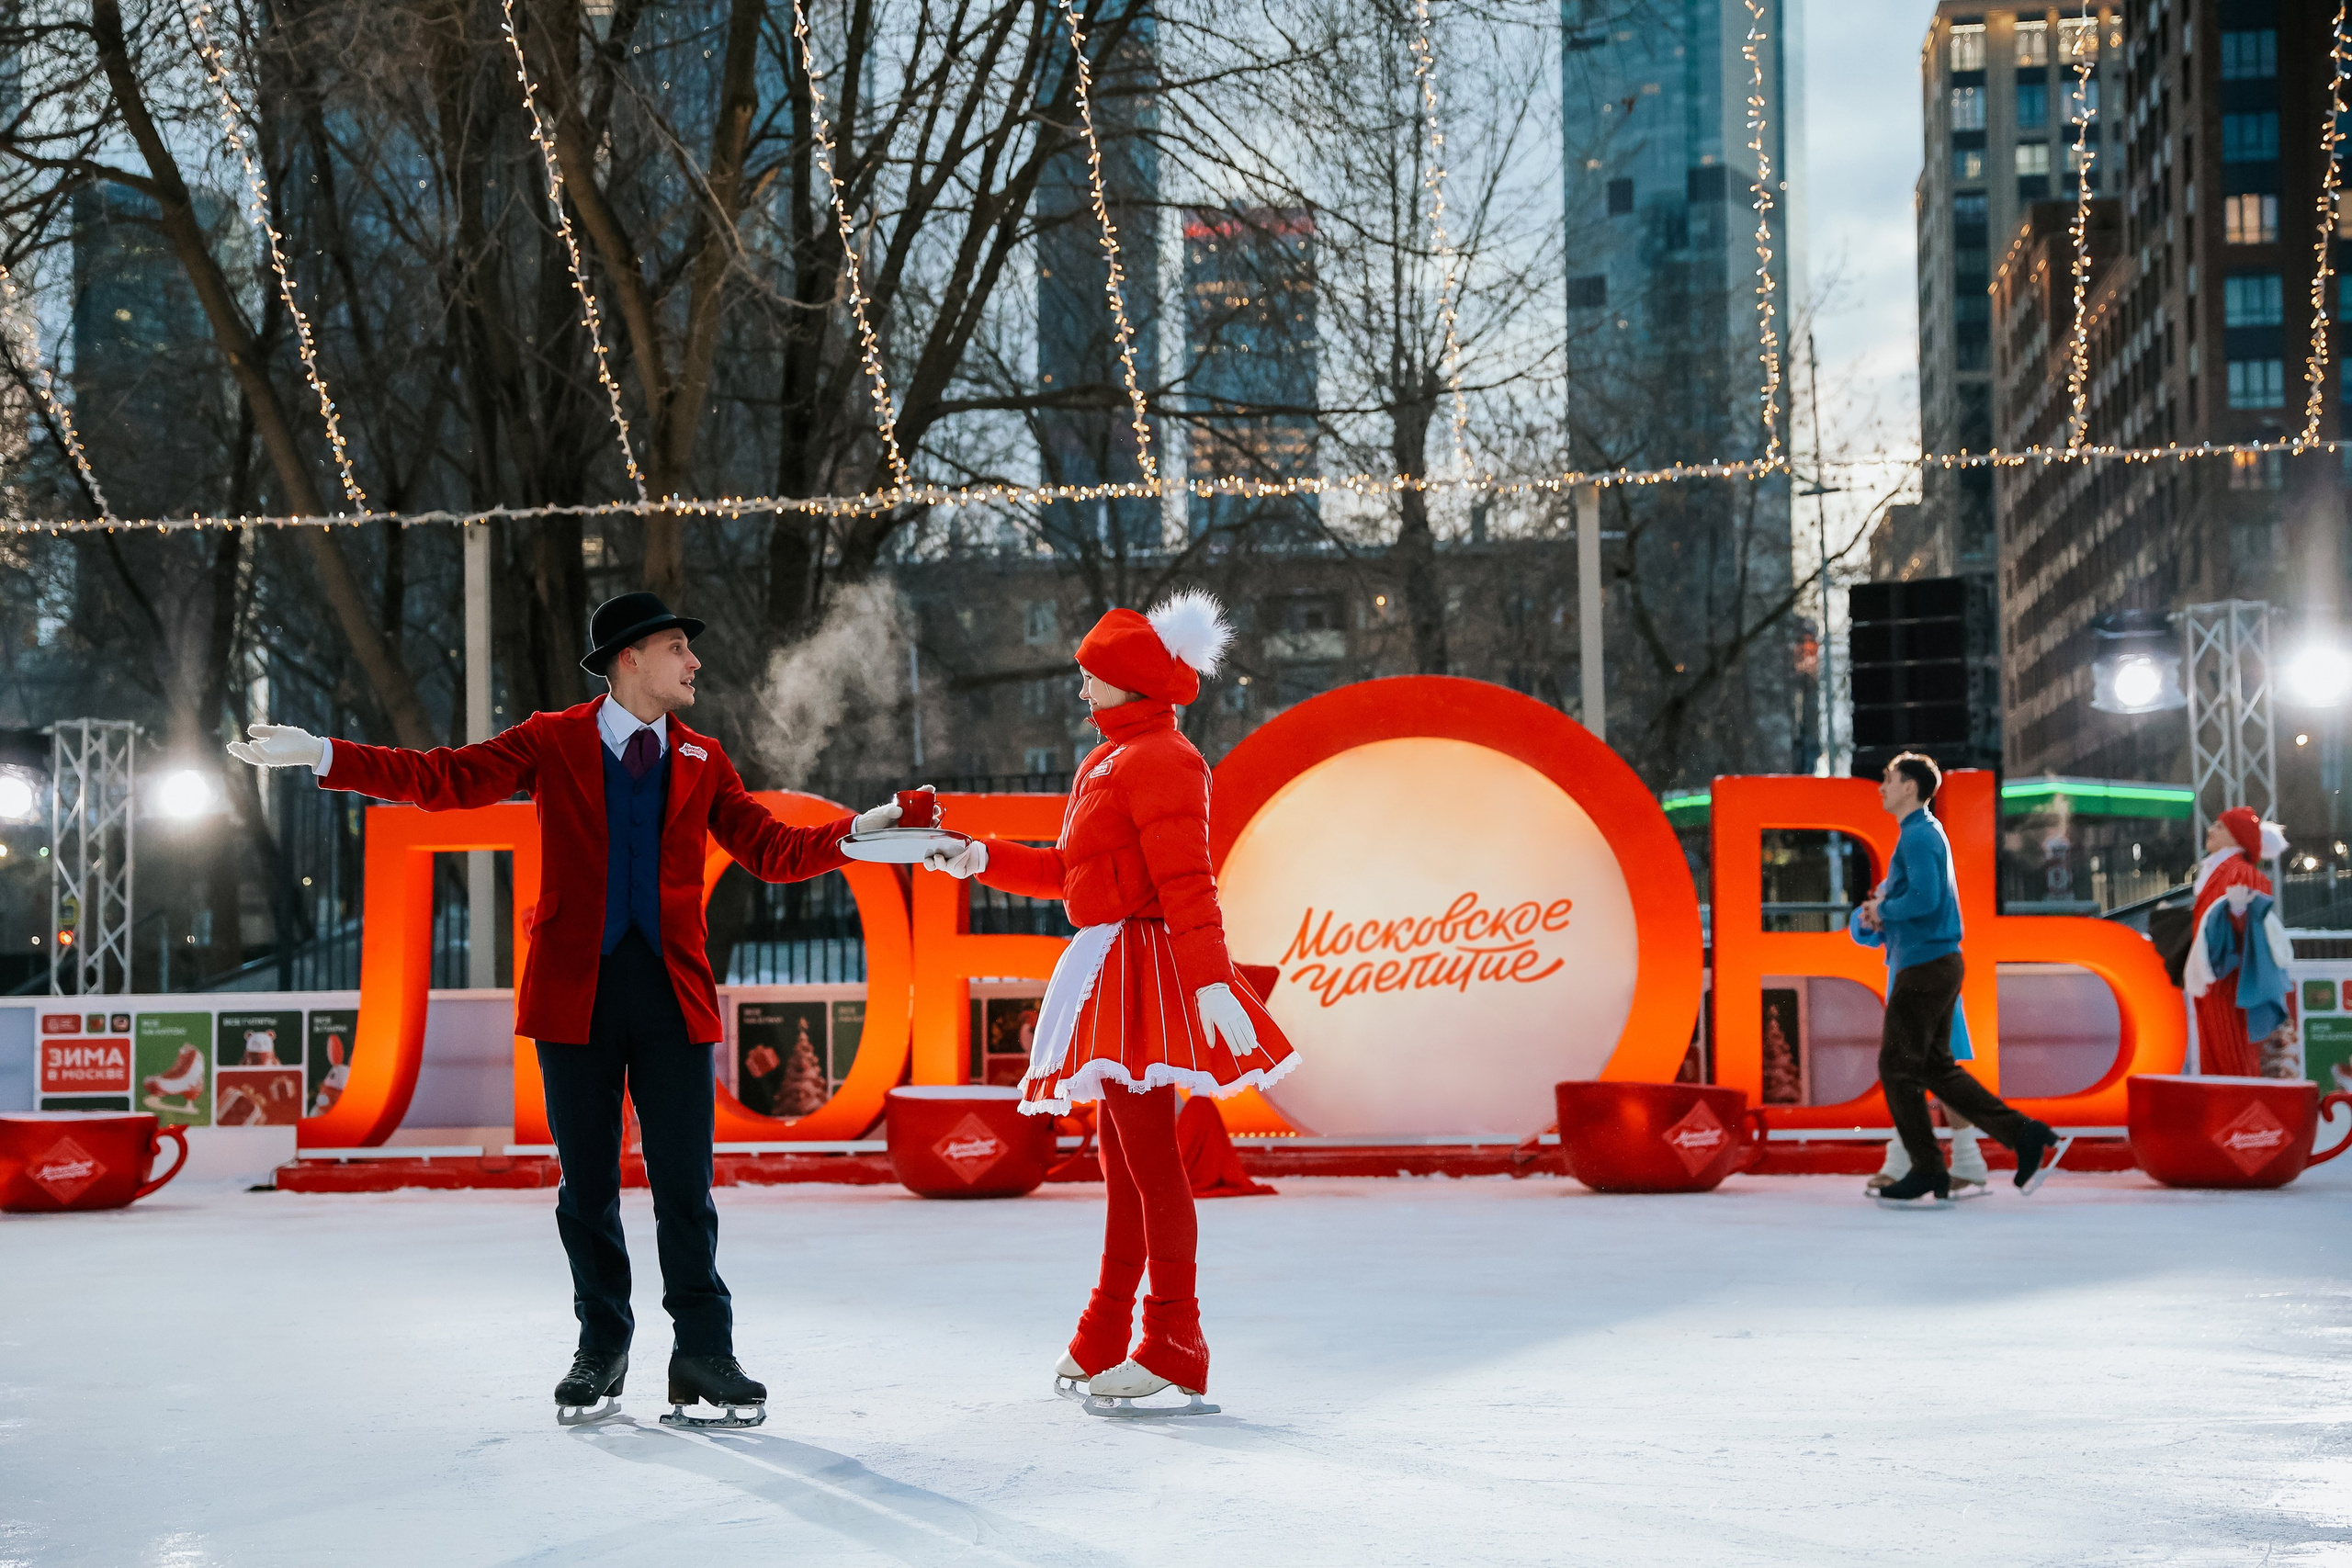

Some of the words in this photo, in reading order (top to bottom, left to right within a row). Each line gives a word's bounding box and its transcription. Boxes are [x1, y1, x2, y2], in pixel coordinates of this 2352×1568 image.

[1279, 891, 1573, 966] Московское
[47, 1047, 124, 1067] ЗИМА
[47, 1068, 58, 1080] В
[62, 1067, 124, 1080] МОСКВЕ
